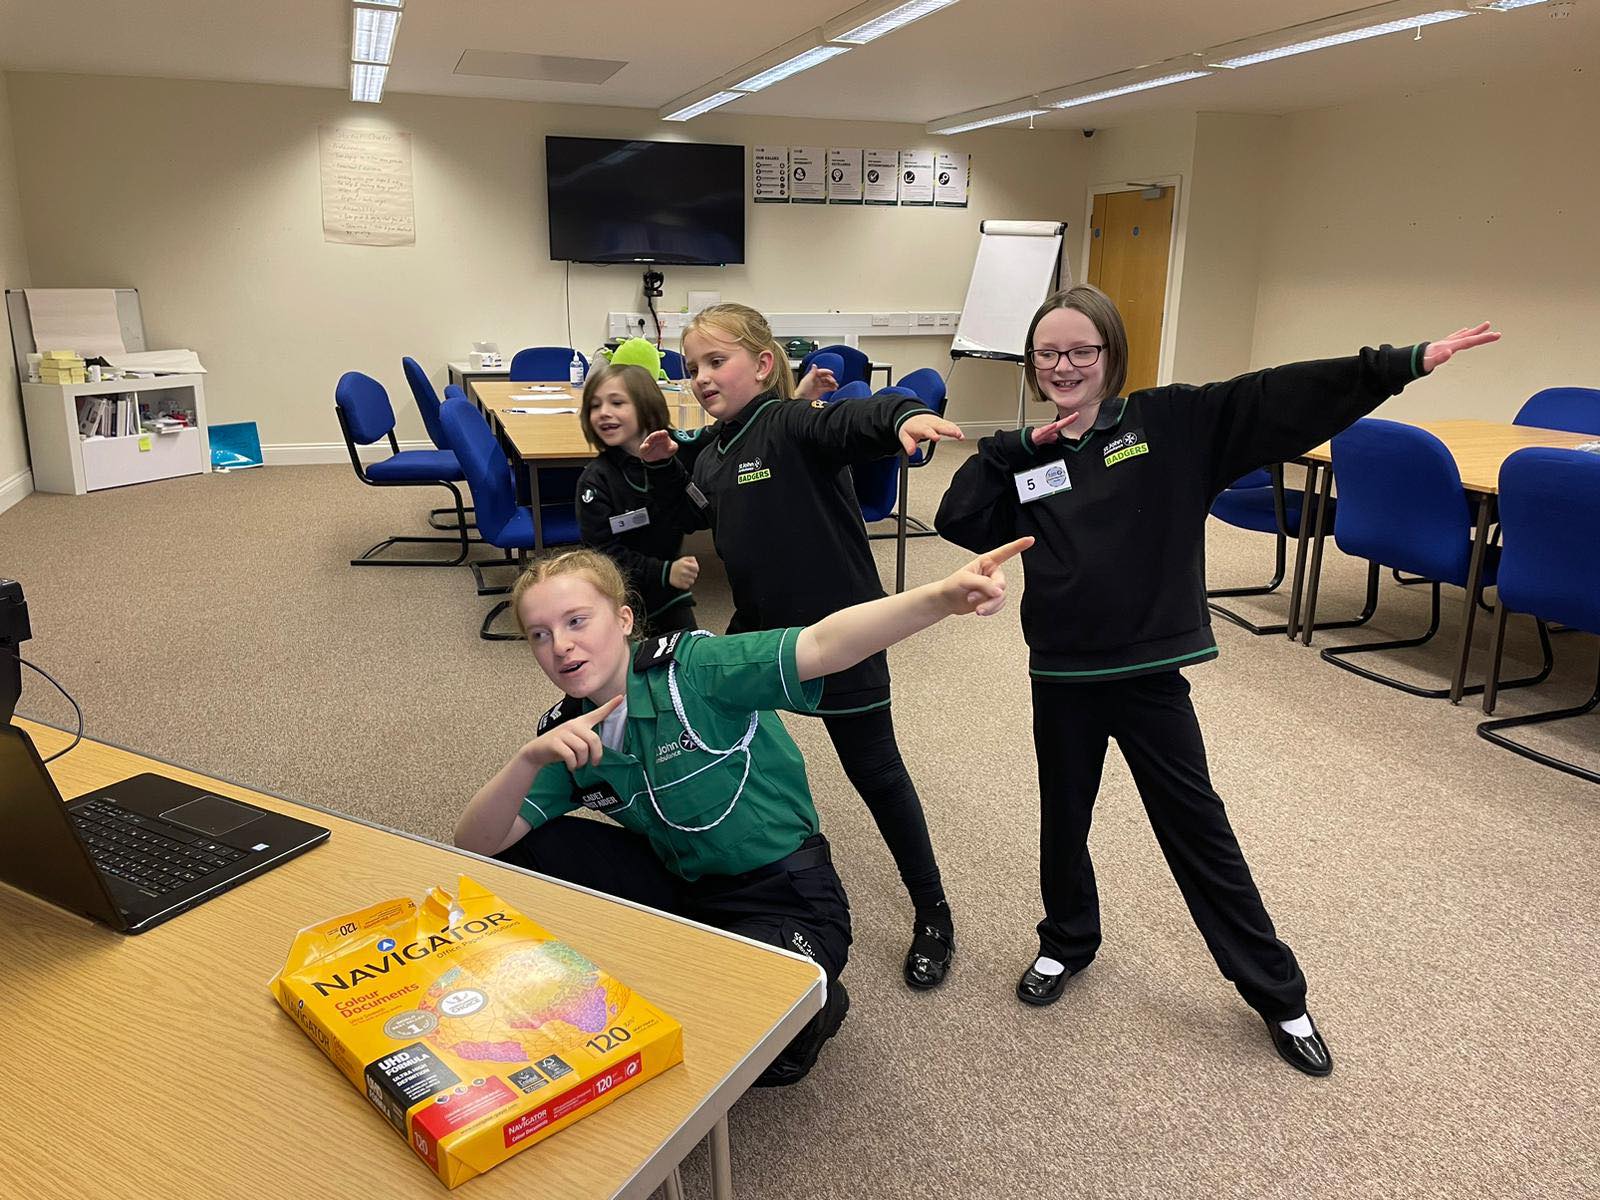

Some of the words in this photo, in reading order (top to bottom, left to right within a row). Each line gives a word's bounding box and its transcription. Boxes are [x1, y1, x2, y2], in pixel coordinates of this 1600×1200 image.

[1106, 444, 1147, 465] BADGERS
[738, 470, 769, 482] BADGERS
[1027, 478, 1035, 490] 5
[618, 520, 625, 528] 3
[659, 741, 679, 756] John
[582, 791, 603, 803] CADET
[340, 922, 358, 936] 120
[311, 911, 512, 996] NAVIGATOR
[437, 945, 461, 959] Office
[335, 990, 380, 1011] Colour
[340, 983, 419, 1018] Documents
[586, 1026, 631, 1054] 120
[378, 1052, 410, 1070] UHD
[385, 1053, 431, 1077] FORMULA
[392, 1070, 412, 1082] ULTRA
[412, 1063, 428, 1073] HIGH
[396, 1068, 431, 1087] DEFINITION
[595, 1074, 613, 1094] 120
[508, 1109, 547, 1135] NAVIGATOR
[414, 1131, 428, 1155] 120
